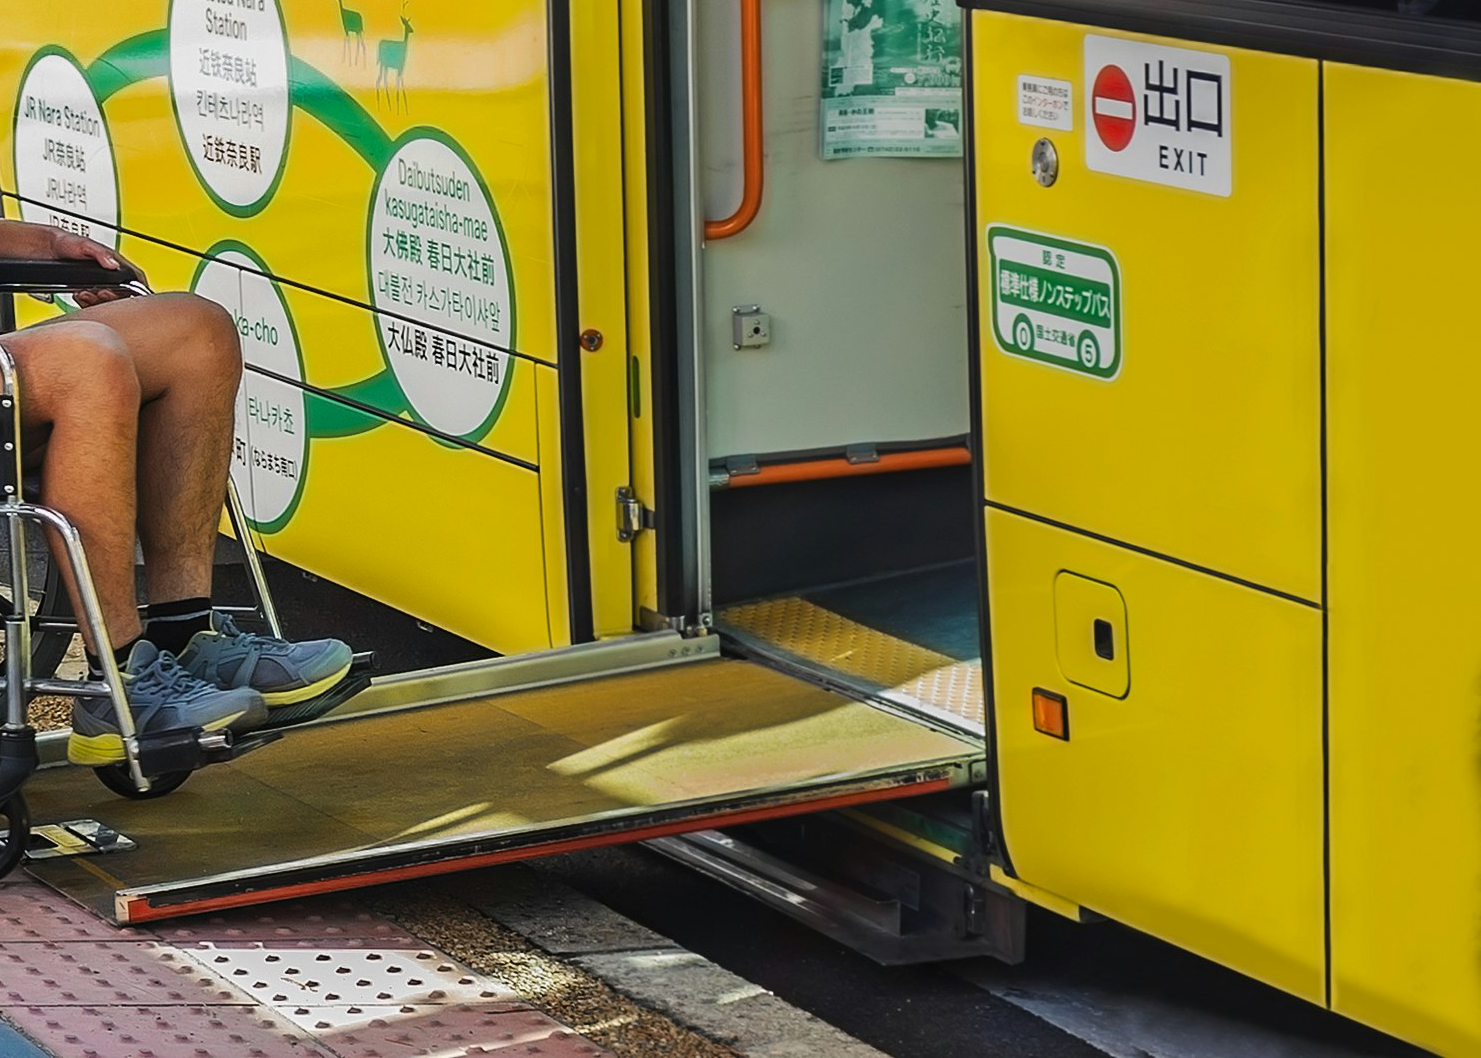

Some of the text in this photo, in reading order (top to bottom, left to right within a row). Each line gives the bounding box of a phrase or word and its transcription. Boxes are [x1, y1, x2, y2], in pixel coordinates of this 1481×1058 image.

[205, 7, 248, 41] Station
[24, 95, 101, 138] JR Nara Station
[1144, 60, 1223, 138] 出口
[42, 137, 87, 174] JR奈良站
[201, 132, 262, 175] 近鉄奈良駅
[1159, 145, 1208, 176] EXIT
[45, 177, 88, 212] JR나라역
[397, 158, 471, 202] Daibutsuden
[385, 188, 489, 243] kasugataisha-mae
[382, 227, 495, 287] 大佛殿 春日大社前
[1000, 269, 1111, 319] 標準仕様ノンステップバス
[387, 321, 500, 385] 大仏殿 春日大社前
